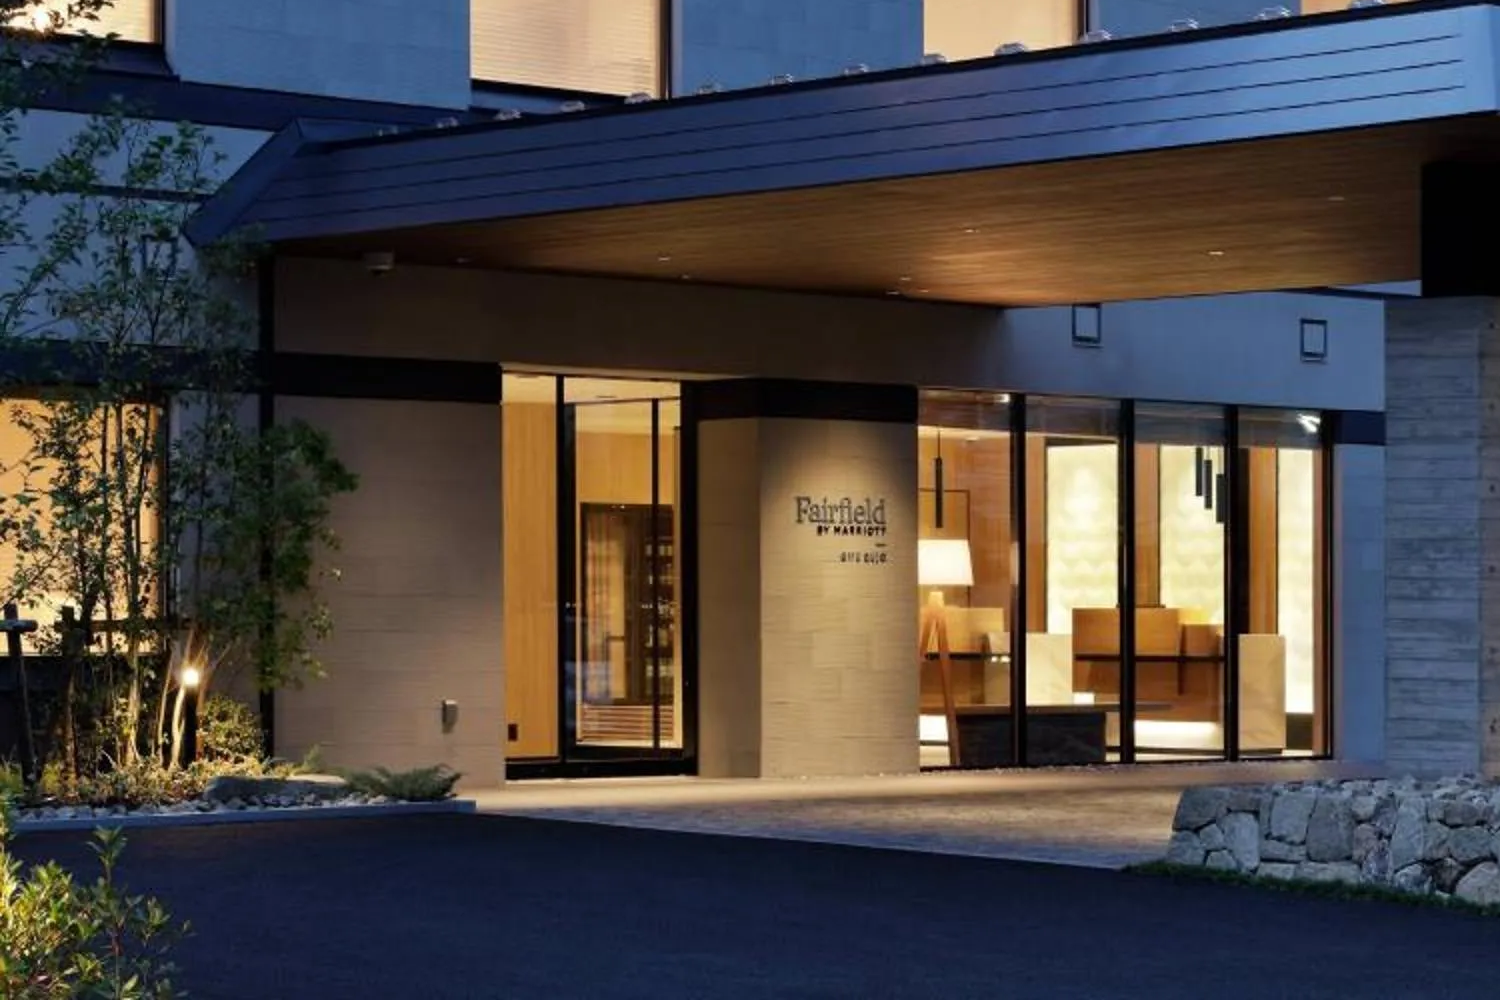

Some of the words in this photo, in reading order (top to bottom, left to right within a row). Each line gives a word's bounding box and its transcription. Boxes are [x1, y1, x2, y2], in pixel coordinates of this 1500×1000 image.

[796, 496, 886, 525] Fairfield
[817, 526, 829, 536] BY
[834, 526, 886, 536] MARRIOTT
